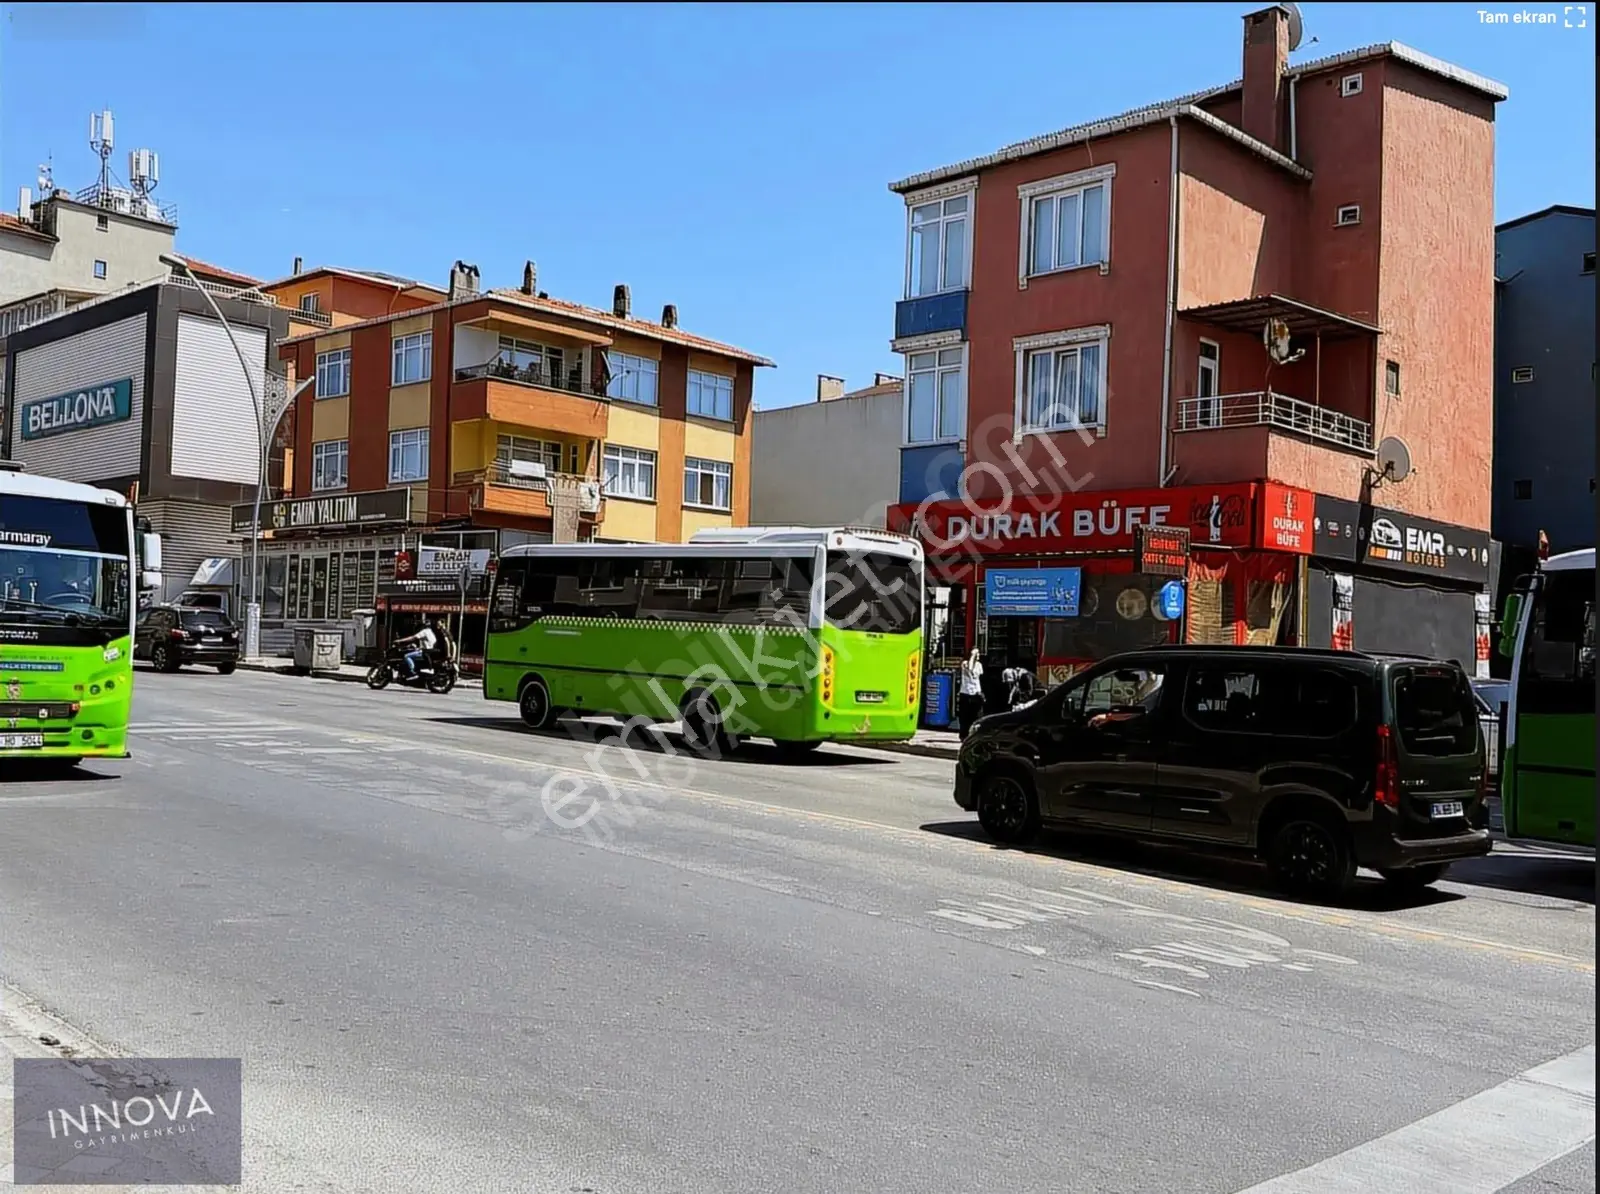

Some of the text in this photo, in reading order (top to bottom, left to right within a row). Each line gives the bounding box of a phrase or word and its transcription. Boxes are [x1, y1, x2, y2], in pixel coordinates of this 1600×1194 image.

[29, 387, 116, 432] BELLONA
[948, 510, 1060, 542] DURAK
[1073, 500, 1170, 537] BÜFE
[1273, 516, 1304, 533] DURAK
[1276, 531, 1301, 549] BÜFE
[1406, 527, 1445, 556] EMR
[1406, 552, 1447, 568] MOTORS
